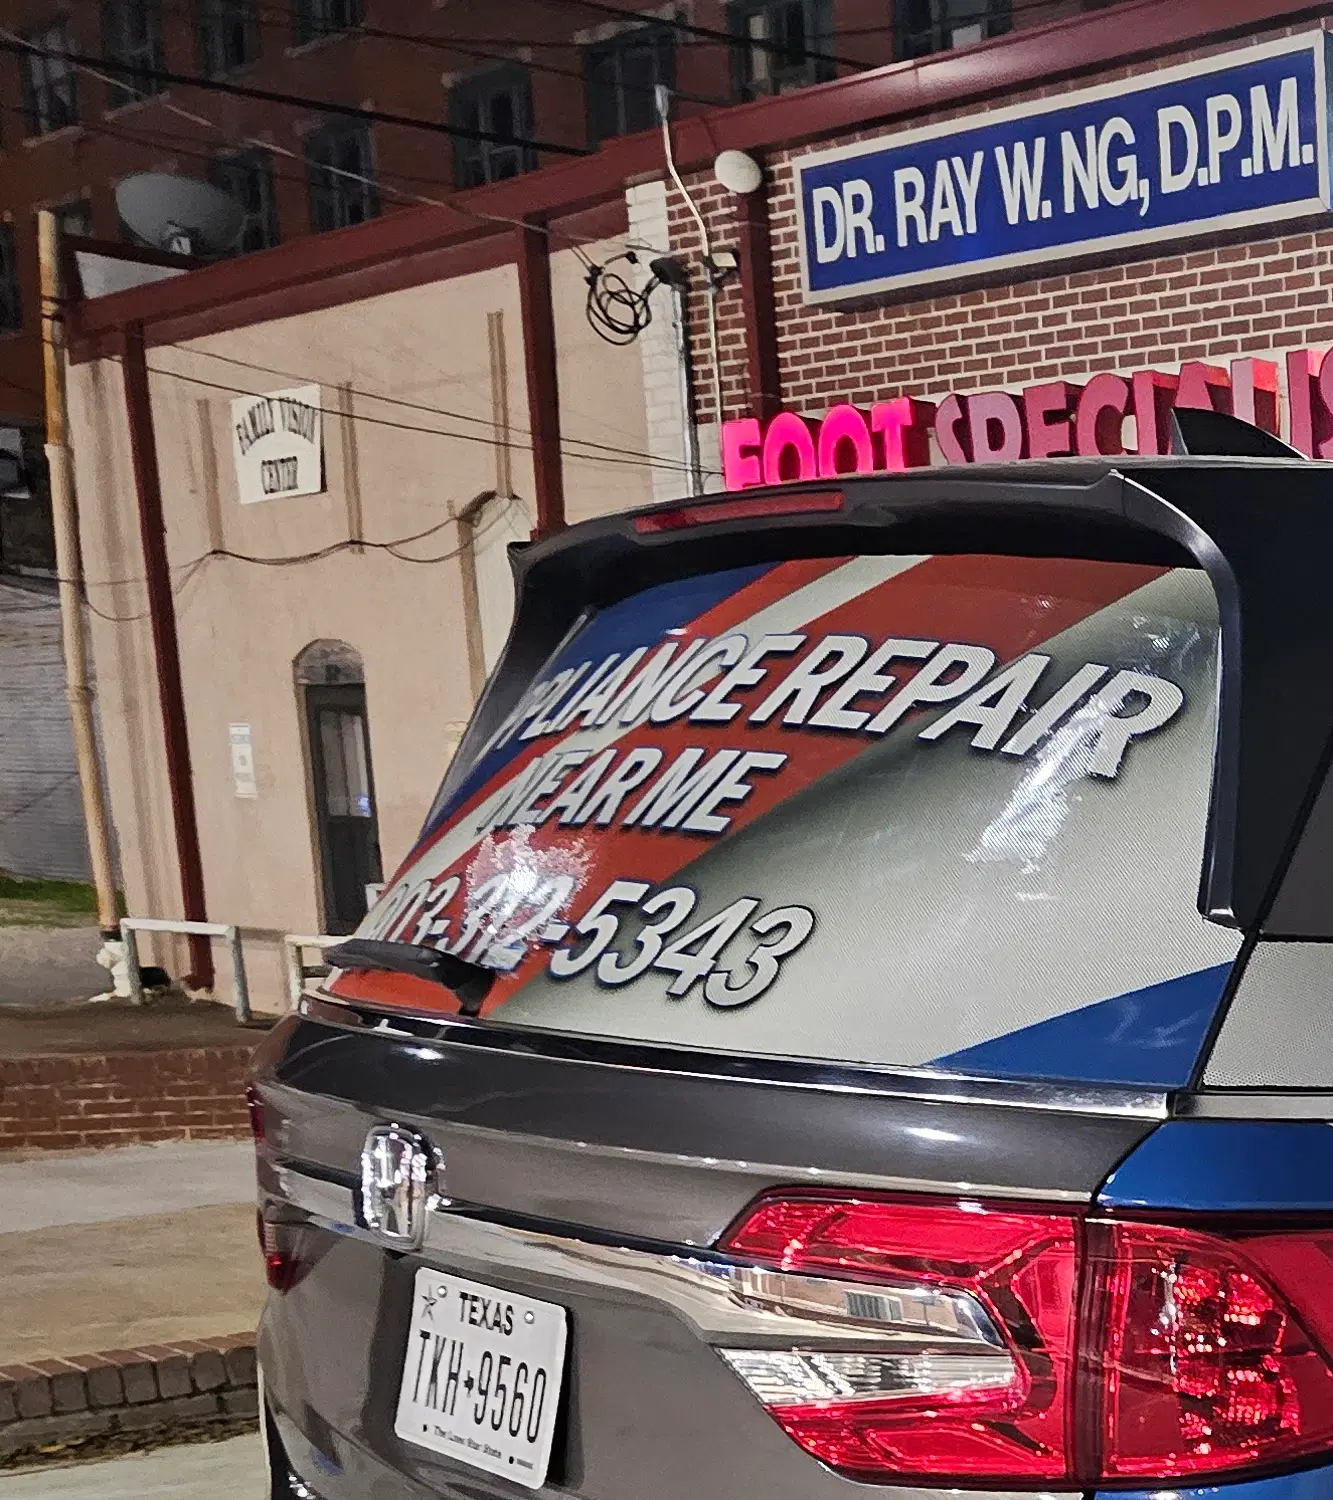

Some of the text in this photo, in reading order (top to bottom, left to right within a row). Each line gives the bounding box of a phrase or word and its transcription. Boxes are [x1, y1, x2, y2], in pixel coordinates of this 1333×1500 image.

[812, 76, 1315, 264] DR. RAY W. NG, D.P.M.
[722, 397, 916, 491] FOOT
[748, 634, 1184, 779] REPAIR
[474, 748, 788, 836] NEAR ME
[459, 1291, 514, 1336] TEXAS
